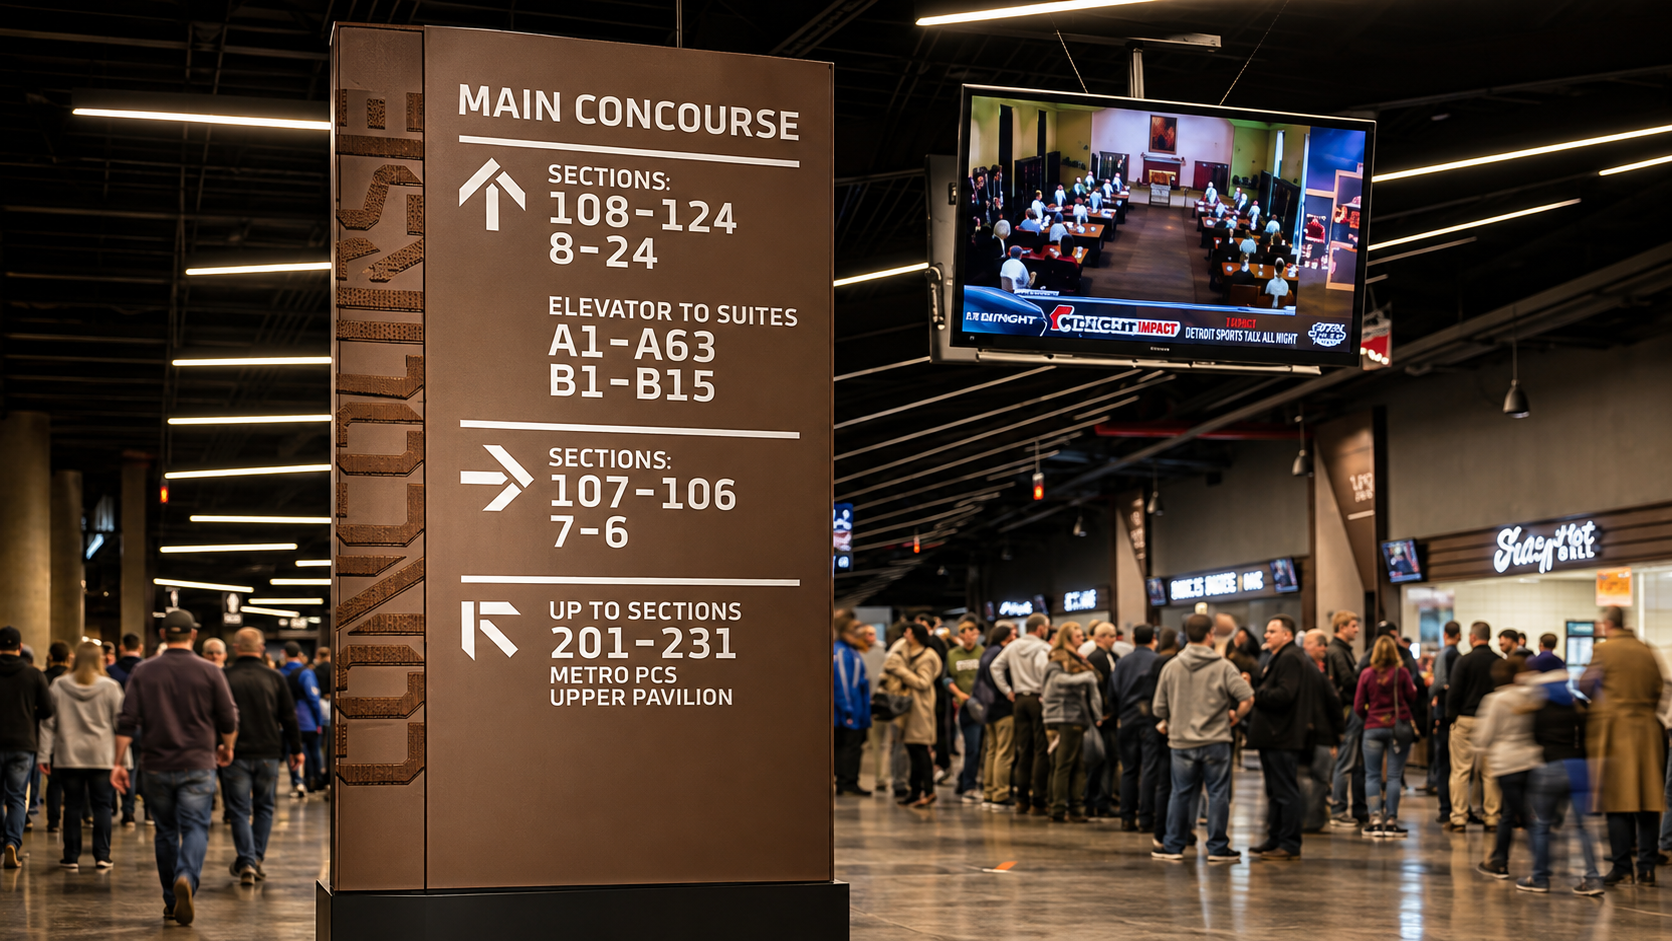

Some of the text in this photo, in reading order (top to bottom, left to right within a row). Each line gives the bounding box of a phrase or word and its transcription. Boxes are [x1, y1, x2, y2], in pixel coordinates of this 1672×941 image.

[458, 83, 800, 141] MAIN CONCOURSE
[548, 164, 671, 190] SECTIONS:
[549, 191, 737, 235] 108-124
[549, 231, 658, 270] 8-24
[548, 296, 798, 328] ELEVATOR TO SUITES
[1138, 321, 1178, 335] IMPACT
[548, 324, 715, 363] A1-A63
[1185, 327, 1215, 340] DETROIT
[1216, 329, 1243, 341] SPORTS
[1262, 331, 1275, 343] ALL
[1276, 332, 1298, 345] NIGHT
[550, 364, 715, 403] B1-B15
[549, 447, 672, 470] SECTIONS:
[551, 473, 736, 511] 107-106
[550, 514, 629, 549] 7-6
[549, 601, 742, 621] UP TO SECTIONS
[551, 626, 737, 659] 201-231
[550, 666, 677, 684] METRO PCS
[550, 688, 733, 707] UPPER PAVILION
